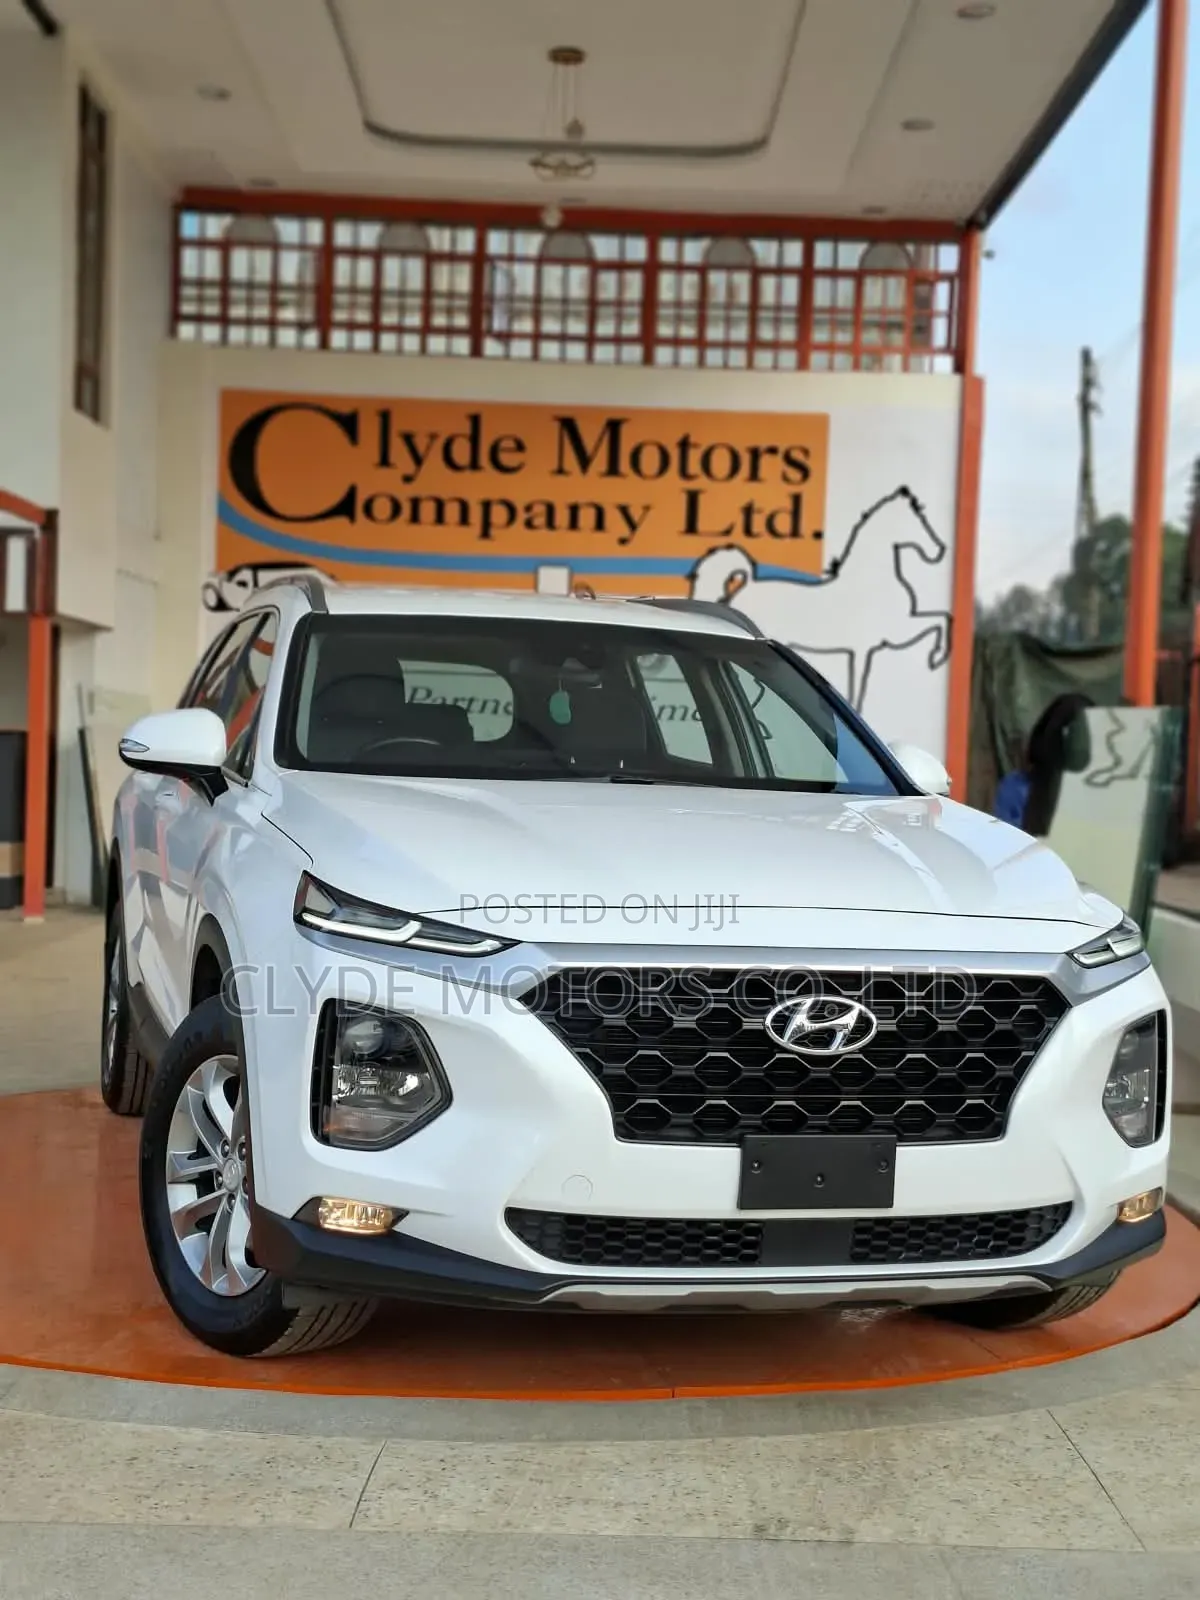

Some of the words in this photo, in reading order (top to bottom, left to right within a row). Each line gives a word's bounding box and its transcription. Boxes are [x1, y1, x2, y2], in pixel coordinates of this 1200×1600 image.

[228, 402, 527, 523] Clyde
[549, 415, 812, 485] Motors
[677, 487, 824, 540] Ltd.
